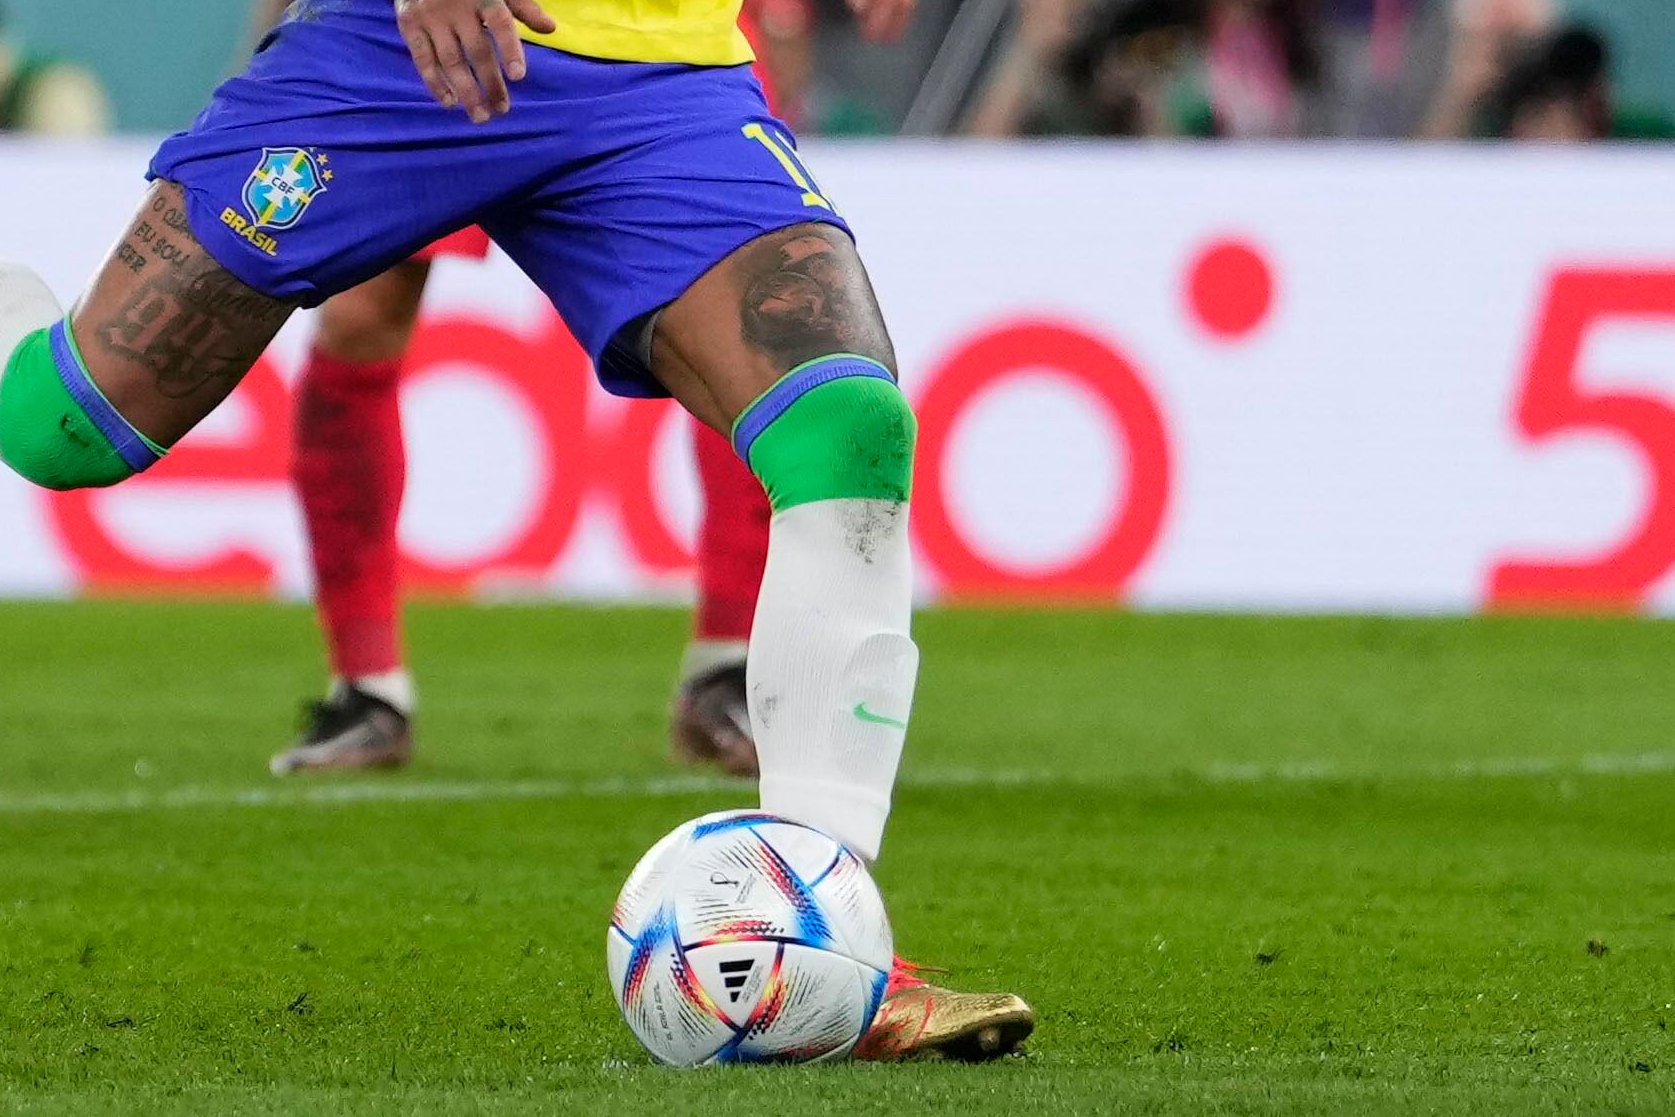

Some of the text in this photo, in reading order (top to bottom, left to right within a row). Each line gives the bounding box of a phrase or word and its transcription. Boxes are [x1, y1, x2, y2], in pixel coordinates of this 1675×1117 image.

[271, 176, 295, 195] CBF
[741, 123, 844, 216] 1
[219, 206, 278, 256] BRASIL
